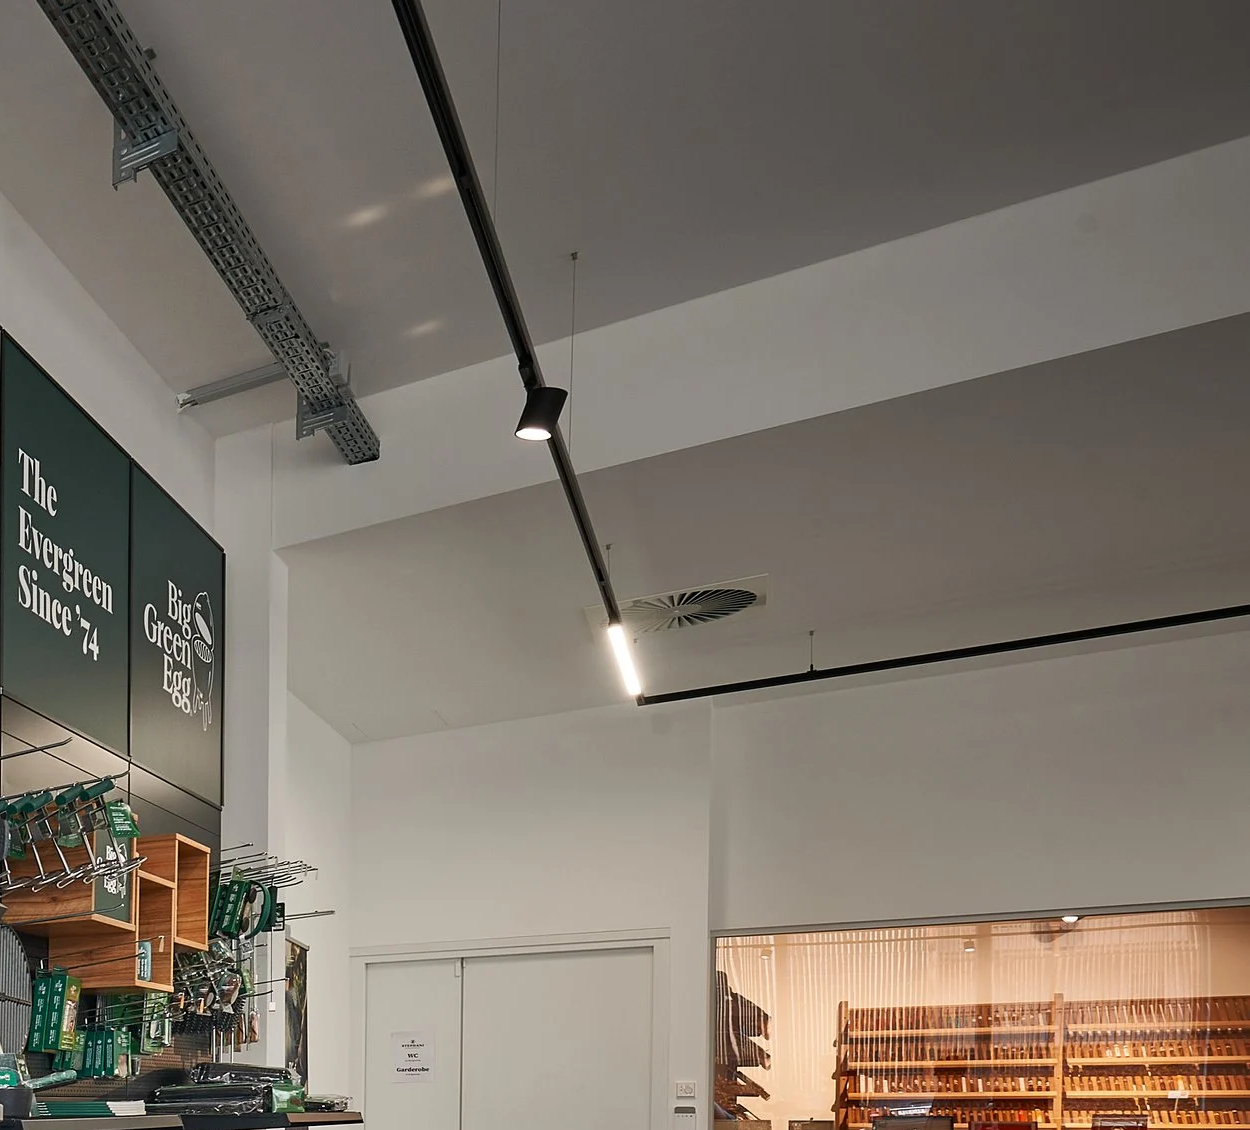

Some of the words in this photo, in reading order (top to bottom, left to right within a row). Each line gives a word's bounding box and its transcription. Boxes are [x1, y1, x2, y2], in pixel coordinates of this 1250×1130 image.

[18, 448, 58, 517] The
[18, 506, 113, 614] Evergreen
[18, 565, 72, 636] Since
[75, 604, 99, 661] ’74
[144, 603, 191, 670] Green
[167, 579, 192, 639] Big
[162, 653, 192, 714] Egg
